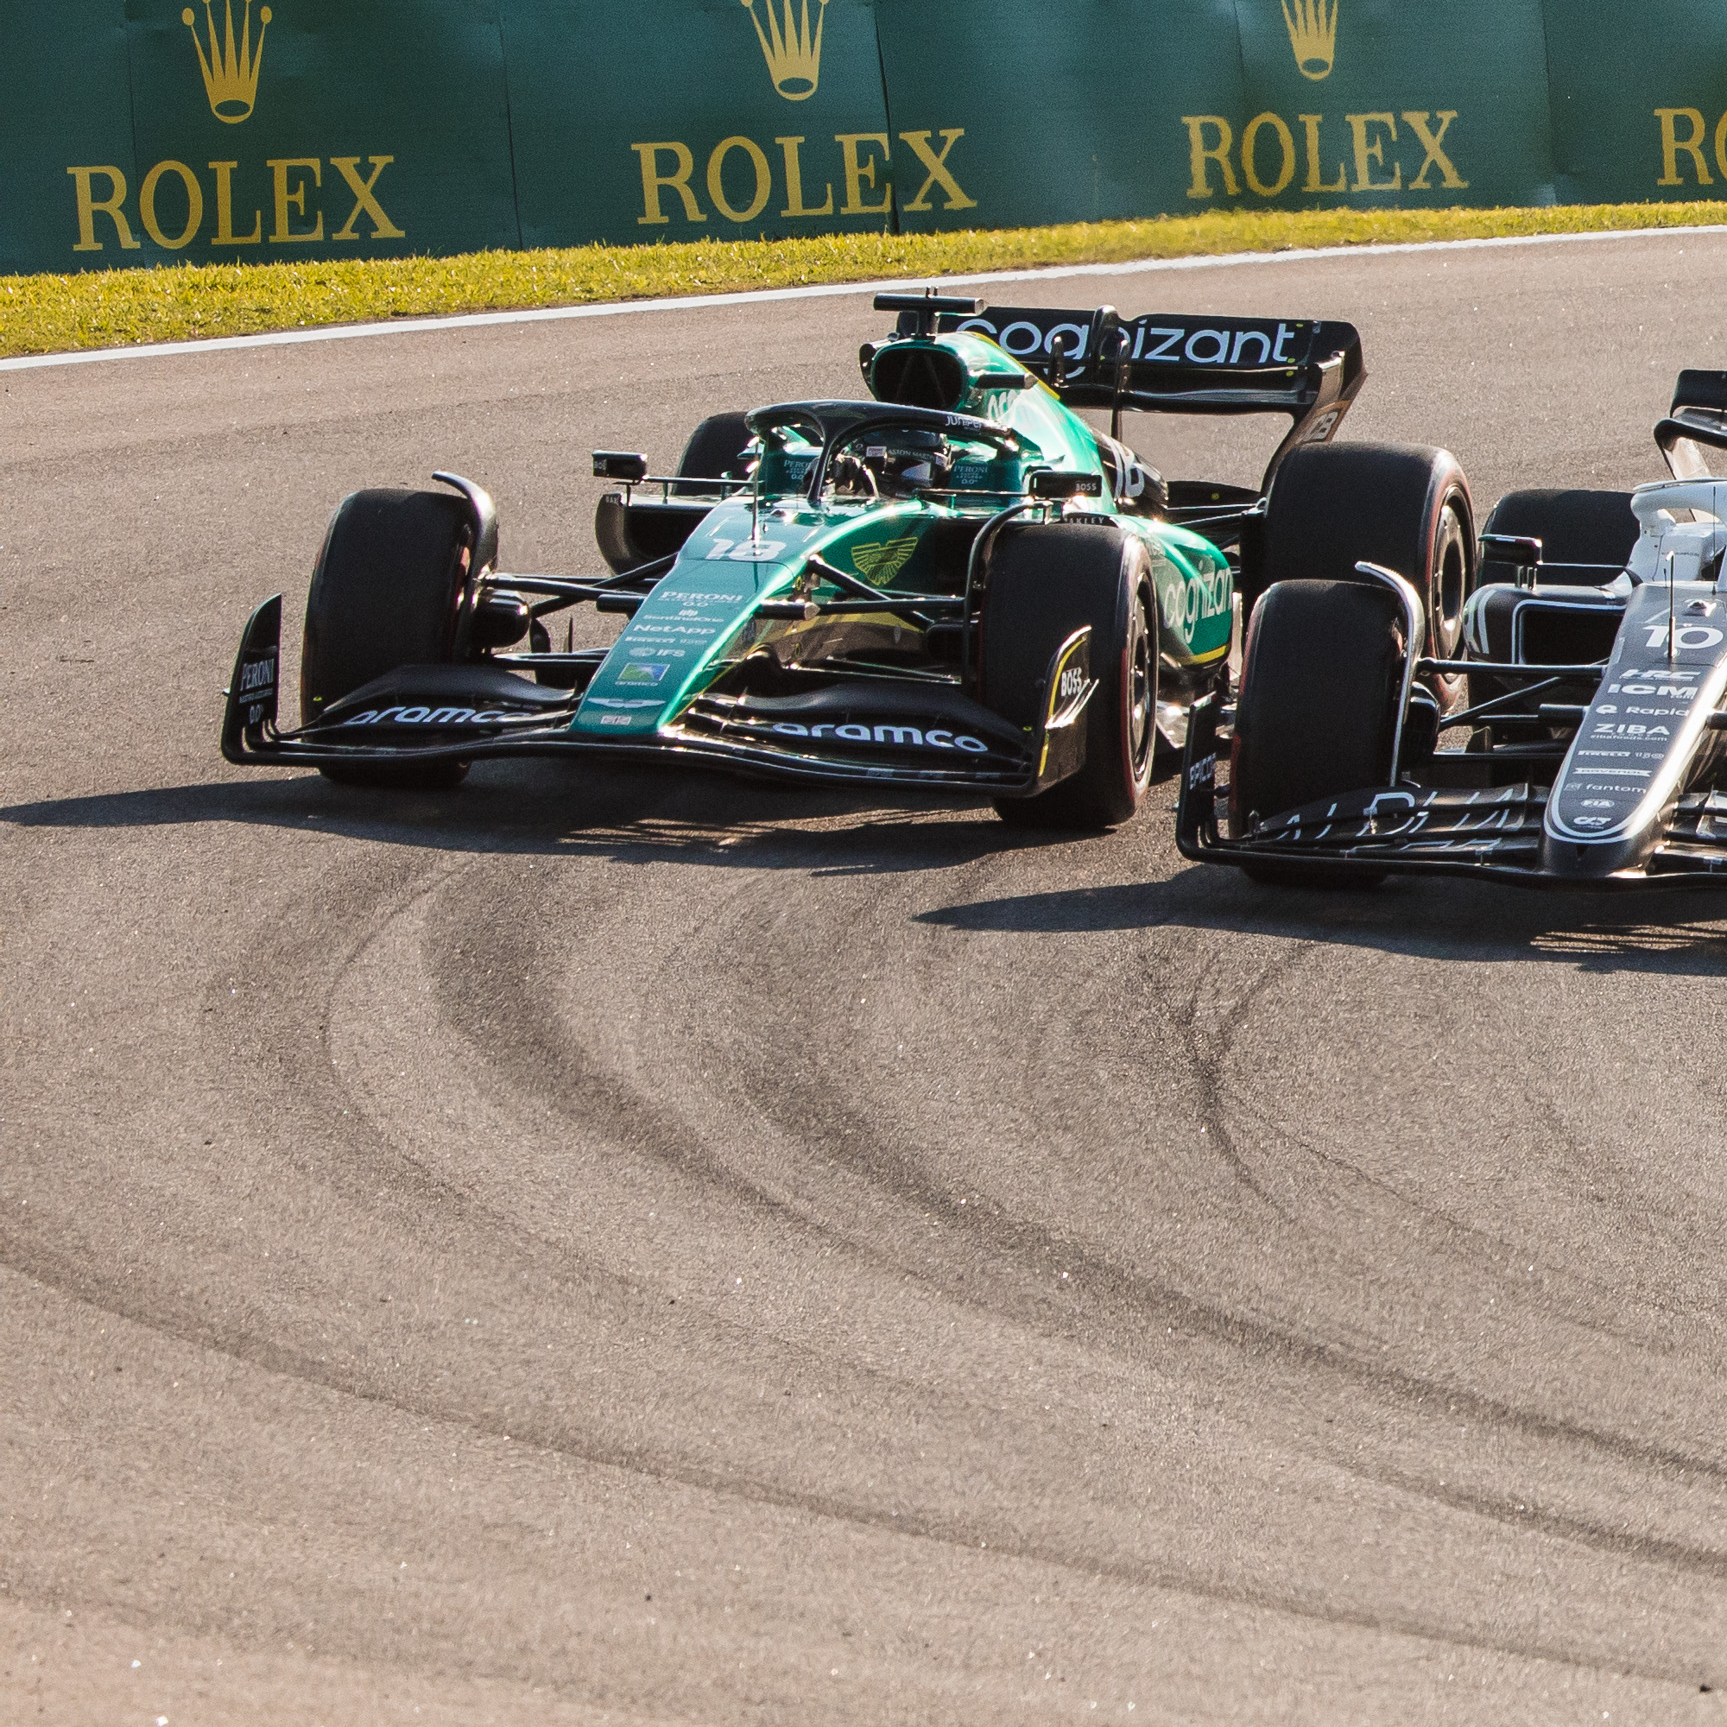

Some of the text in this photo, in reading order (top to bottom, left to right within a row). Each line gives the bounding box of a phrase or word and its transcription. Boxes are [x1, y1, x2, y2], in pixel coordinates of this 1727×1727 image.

[1182, 111, 1468, 198] ROLEX
[631, 128, 976, 224] ROLEX
[67, 156, 414, 251] ROLEX
[957, 318, 1295, 379] cogizant
[953, 464, 988, 473] PERONI
[1075, 482, 1097, 491] BOSS
[706, 538, 787, 561] 18
[660, 591, 743, 602] PERONI
[632, 624, 716, 635] NetApp
[1642, 625, 1724, 650] 10
[656, 649, 685, 658] IFS
[240, 658, 275, 692] PERONI
[1061, 667, 1083, 697] BOSS
[342, 706, 535, 725] aramco
[772, 723, 989, 753] aramco
[1593, 723, 1670, 736] ZIBA
[1586, 783, 1647, 794] fantom
